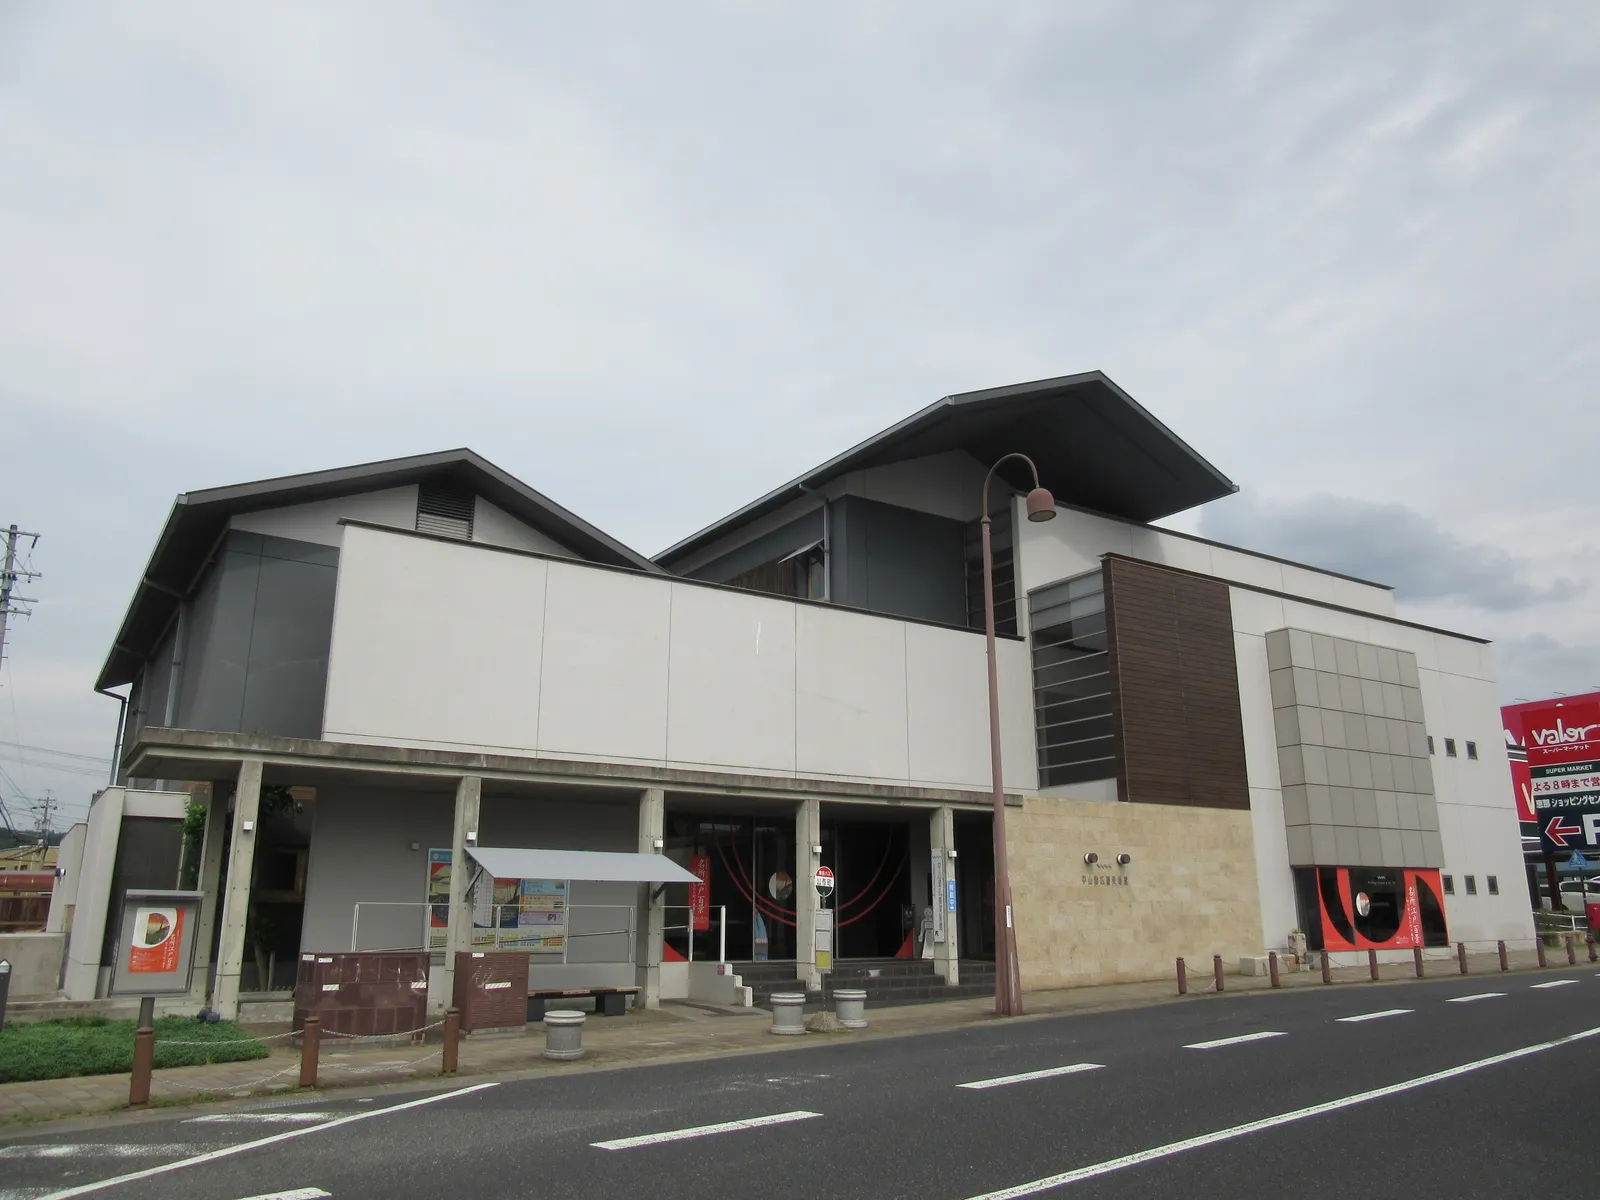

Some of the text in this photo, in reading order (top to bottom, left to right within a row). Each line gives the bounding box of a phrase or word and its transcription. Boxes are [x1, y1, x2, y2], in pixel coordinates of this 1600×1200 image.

[1542, 743, 1589, 754] スーパーマーケット
[1566, 764, 1593, 772] MARKET
